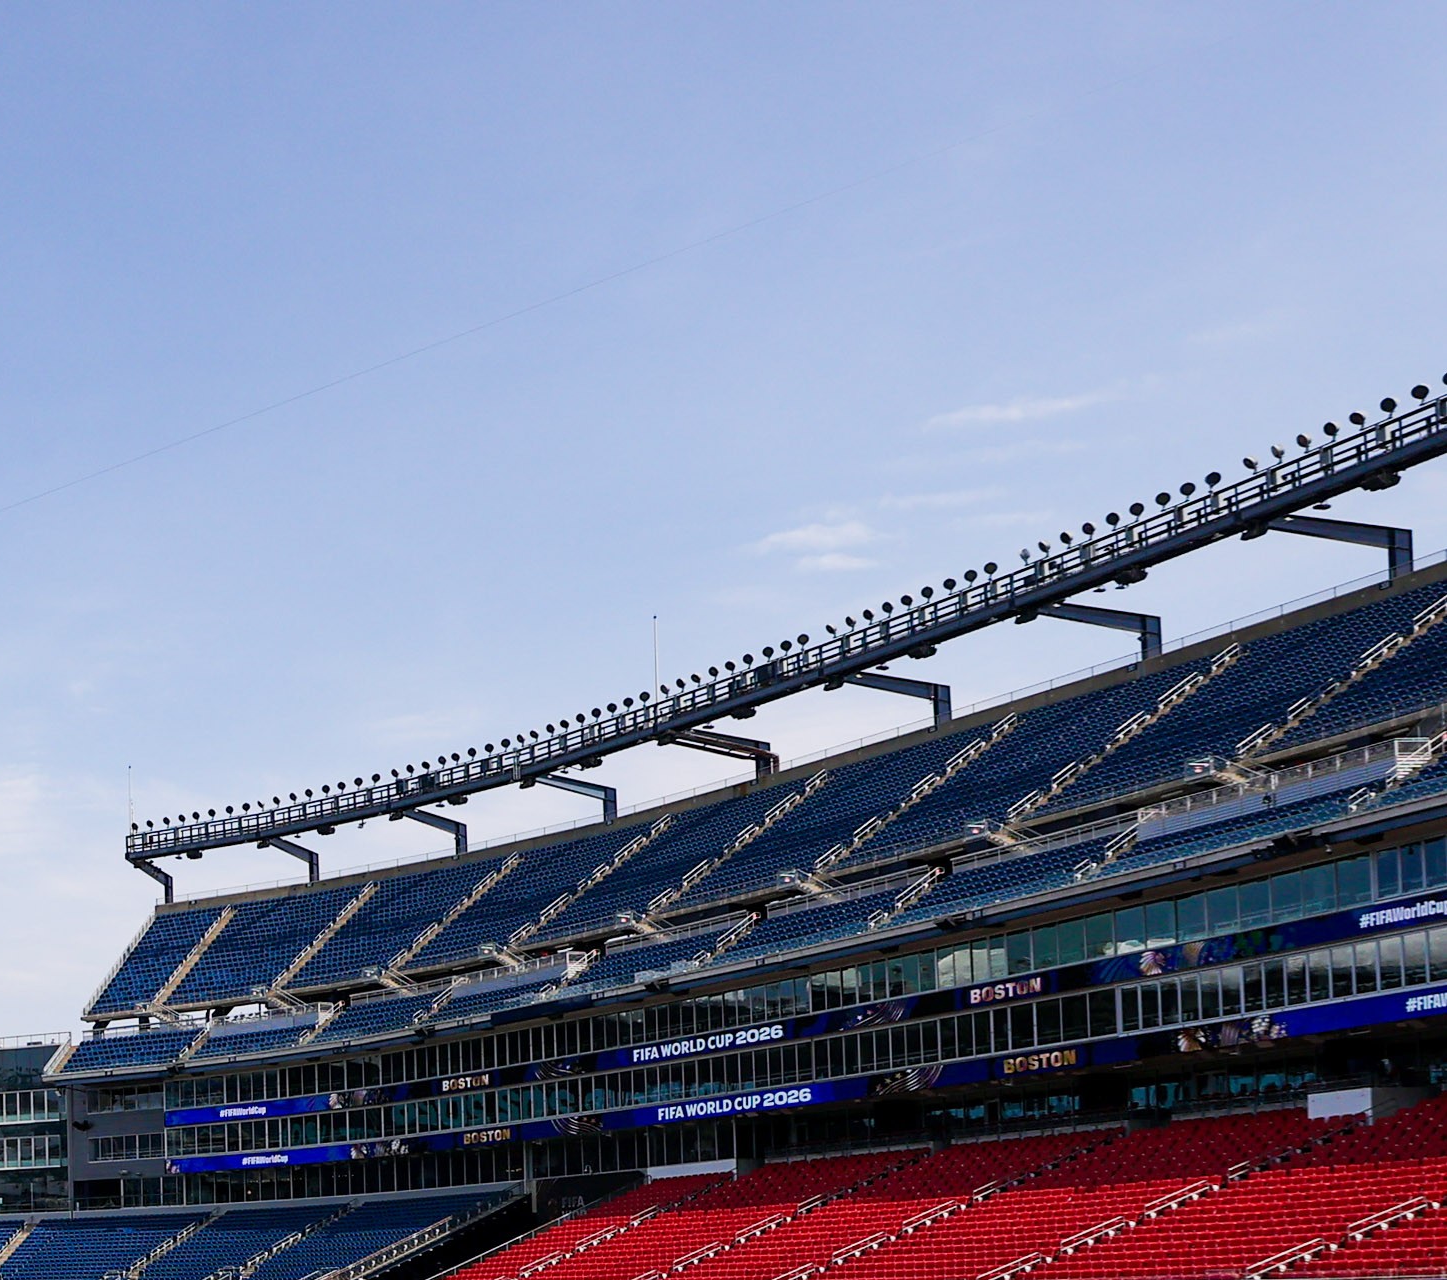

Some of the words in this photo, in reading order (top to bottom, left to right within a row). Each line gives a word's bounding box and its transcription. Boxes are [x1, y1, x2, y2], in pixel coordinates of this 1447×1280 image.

[970, 977, 1042, 1004] BOSTON
[633, 1047, 660, 1063] FIFA
[661, 1038, 706, 1058] WORLD
[707, 1033, 734, 1051] CUP
[735, 1024, 784, 1045] 2026
[1003, 1049, 1076, 1074] BOSTON
[442, 1073, 490, 1092] BOSTON
[219, 1105, 267, 1118] #FIFAWorldCup
[657, 1105, 684, 1121] FIFA
[685, 1098, 733, 1117] WORLD
[733, 1094, 761, 1111] CUP
[762, 1088, 812, 1107] 2026
[463, 1128, 511, 1145] BOSTON
[241, 1154, 289, 1166] #FIFAWorldCup
